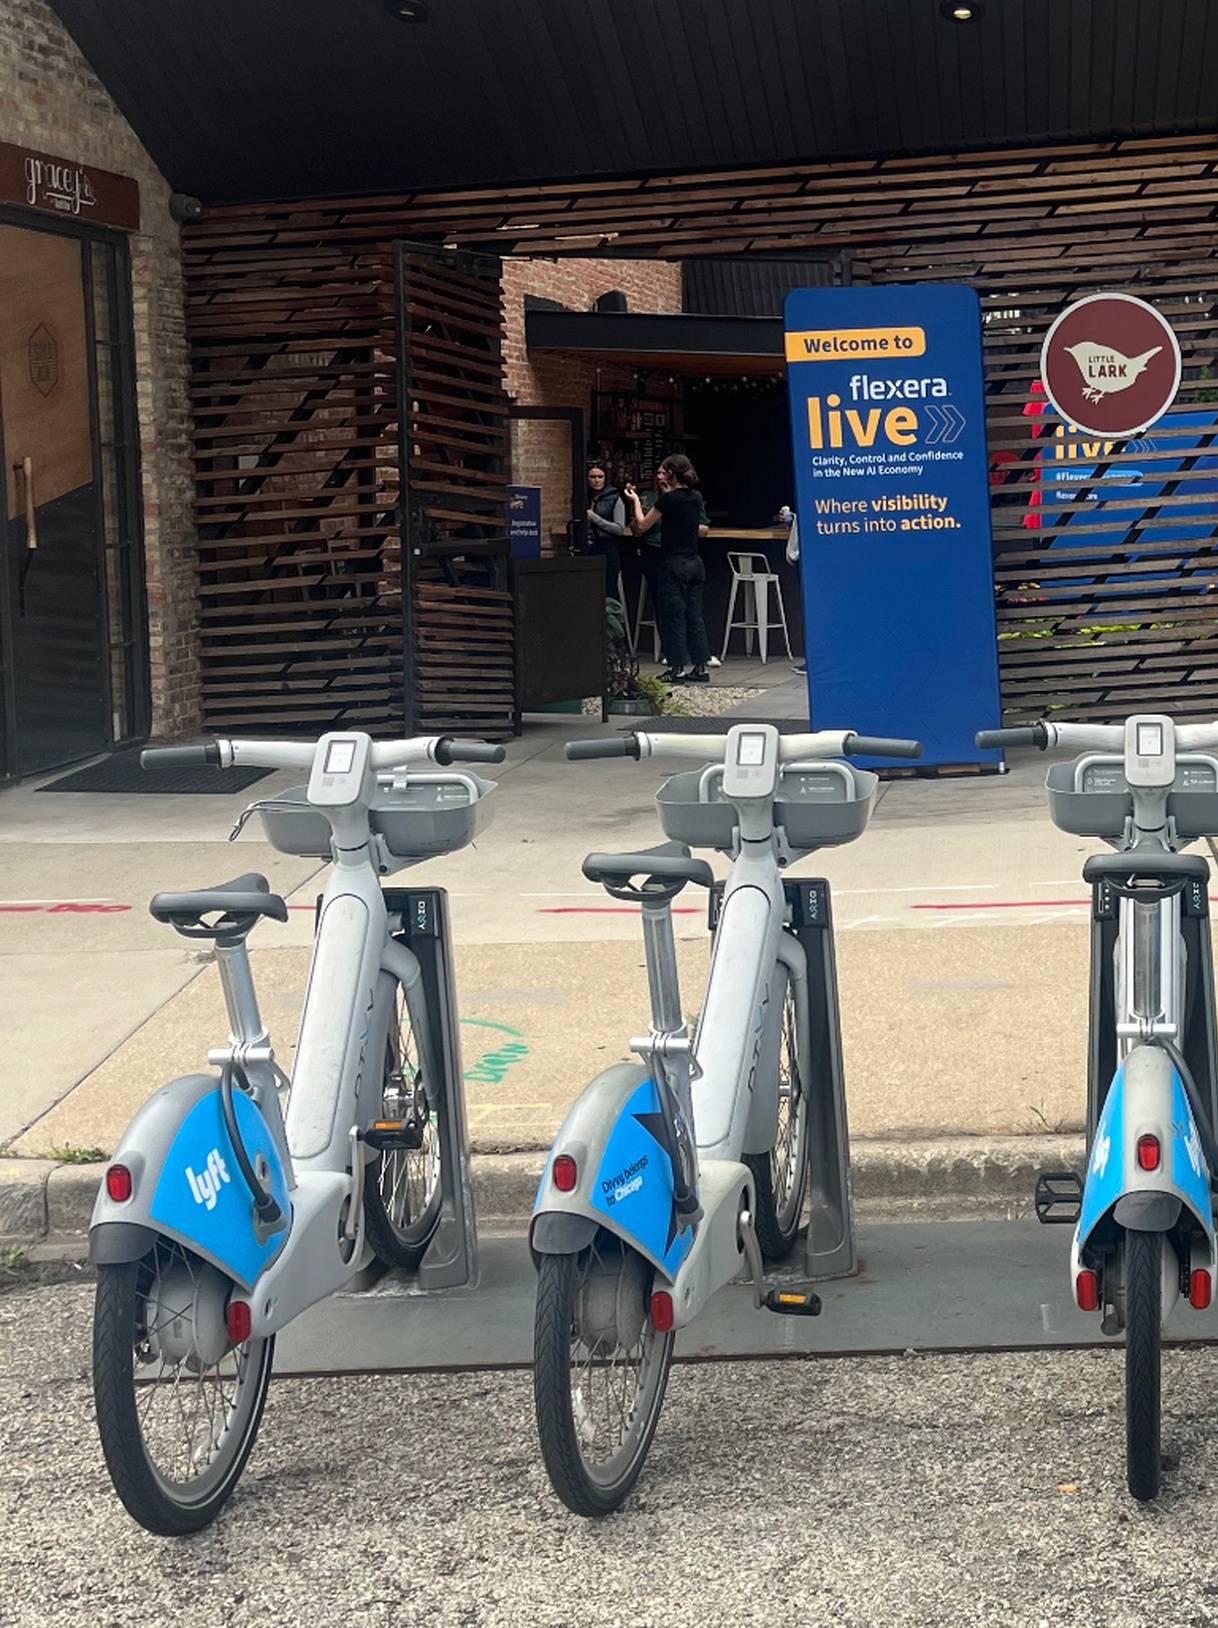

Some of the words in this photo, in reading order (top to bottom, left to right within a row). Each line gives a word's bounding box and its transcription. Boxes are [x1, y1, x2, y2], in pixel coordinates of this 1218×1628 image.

[804, 337, 889, 354] Welcome
[894, 334, 914, 349] to
[1088, 355, 1115, 363] LITTLE
[1088, 364, 1127, 378] LARK
[850, 375, 948, 400] flexera
[807, 393, 919, 449] live
[812, 455, 848, 468] Clarity,
[849, 453, 887, 464] Control
[888, 452, 906, 463] and
[908, 450, 964, 462] Confidence
[813, 467, 823, 478] in
[824, 467, 841, 478] the
[843, 466, 865, 476] New
[878, 465, 924, 476] Economy
[815, 498, 868, 514] Where
[871, 493, 948, 513] visibility
[816, 519, 860, 535] turns
[864, 517, 896, 533] into
[900, 513, 961, 531] action.
[185, 1148, 231, 1211] lyft
[605, 1194, 617, 1208] to
[615, 1175, 643, 1202] Chicago
